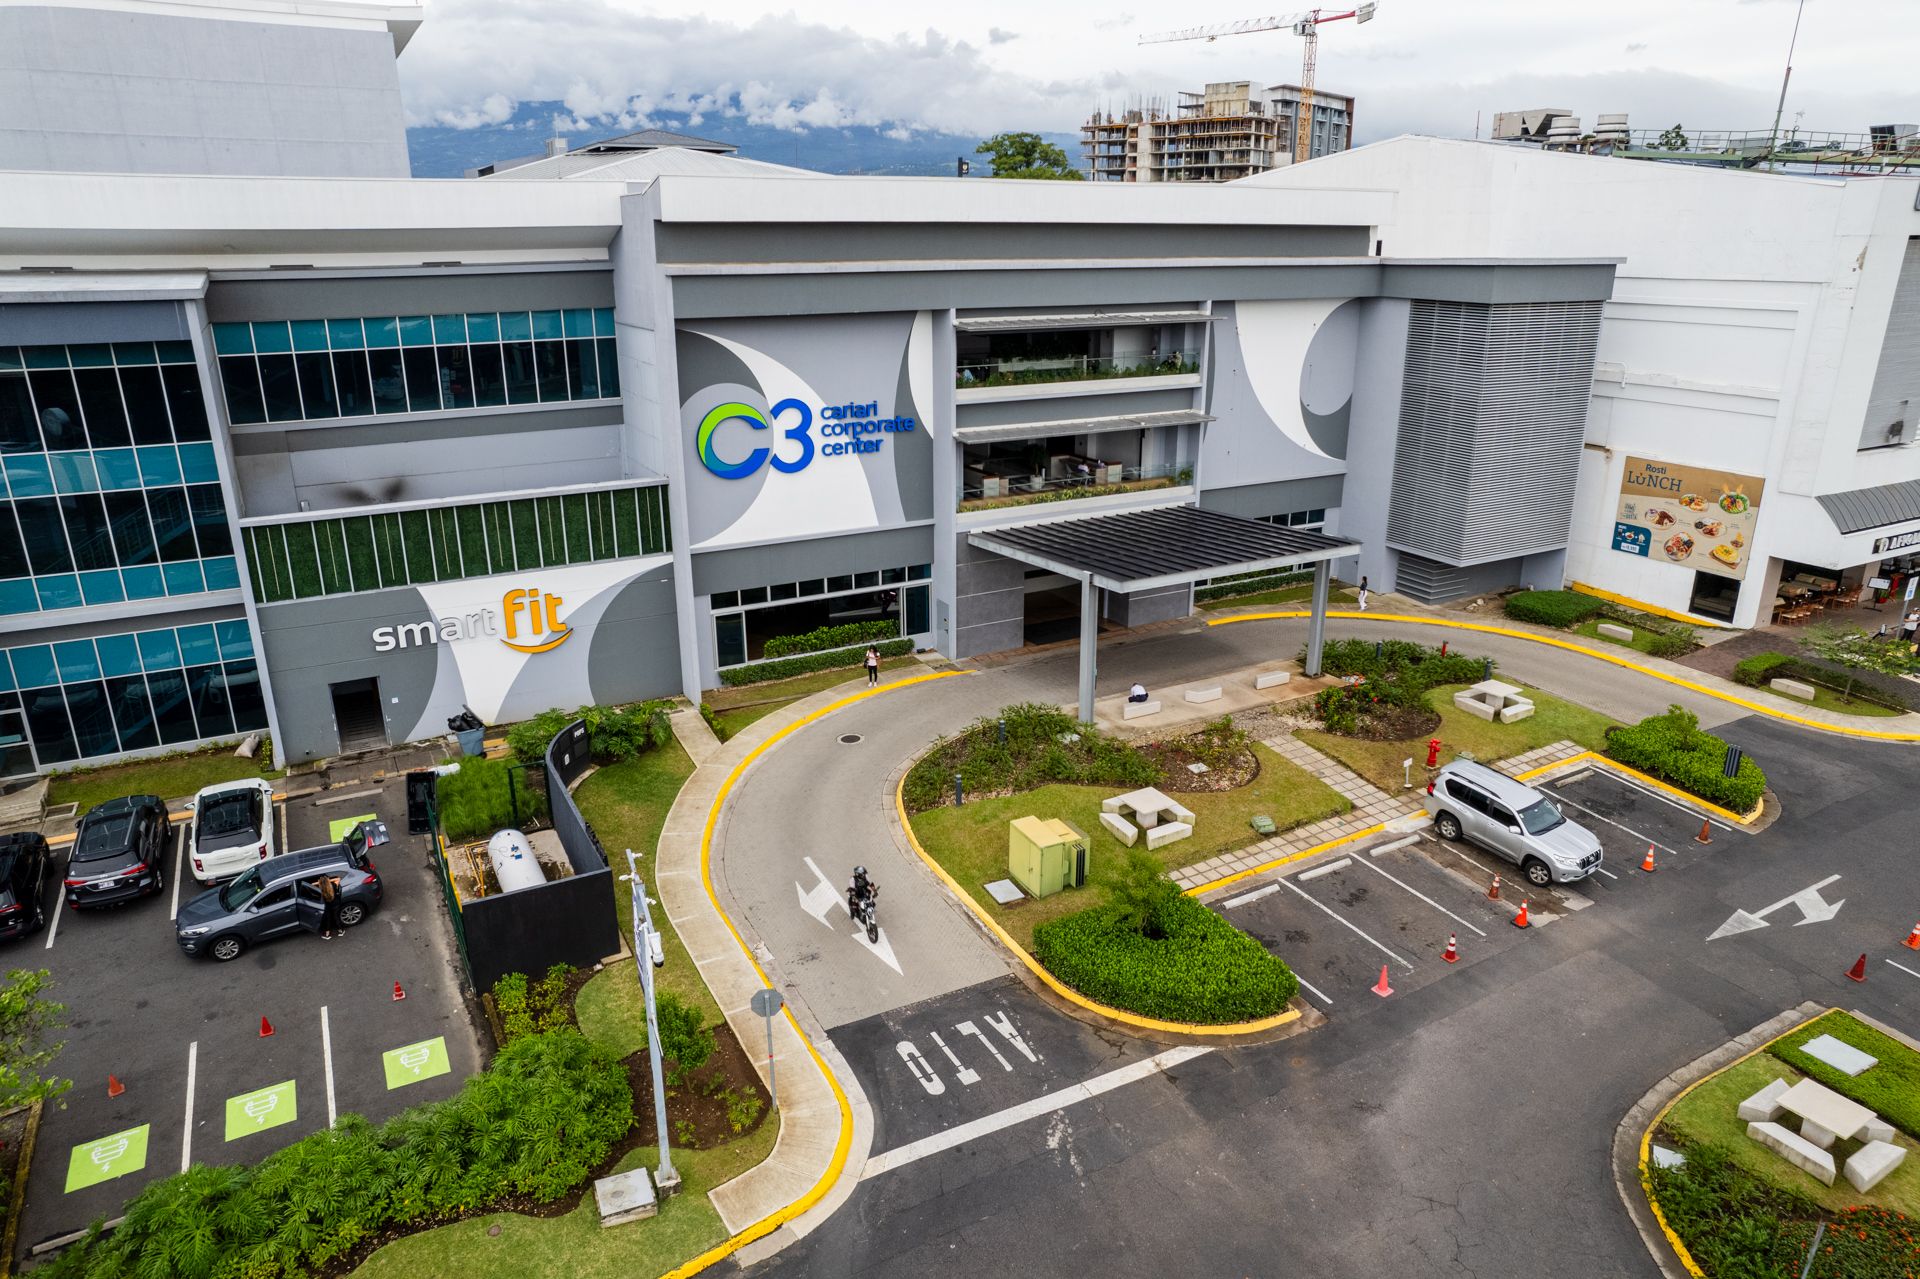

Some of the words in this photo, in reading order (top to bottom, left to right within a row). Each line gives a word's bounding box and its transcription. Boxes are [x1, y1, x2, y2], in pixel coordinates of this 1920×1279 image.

[820, 400, 878, 419] cariari
[820, 415, 916, 438] corporate
[821, 437, 884, 457] center
[1645, 463, 1667, 475] Rosti
[372, 608, 497, 652] smart
[502, 588, 567, 639] fit
[896, 1010, 1038, 1095] ALTO
